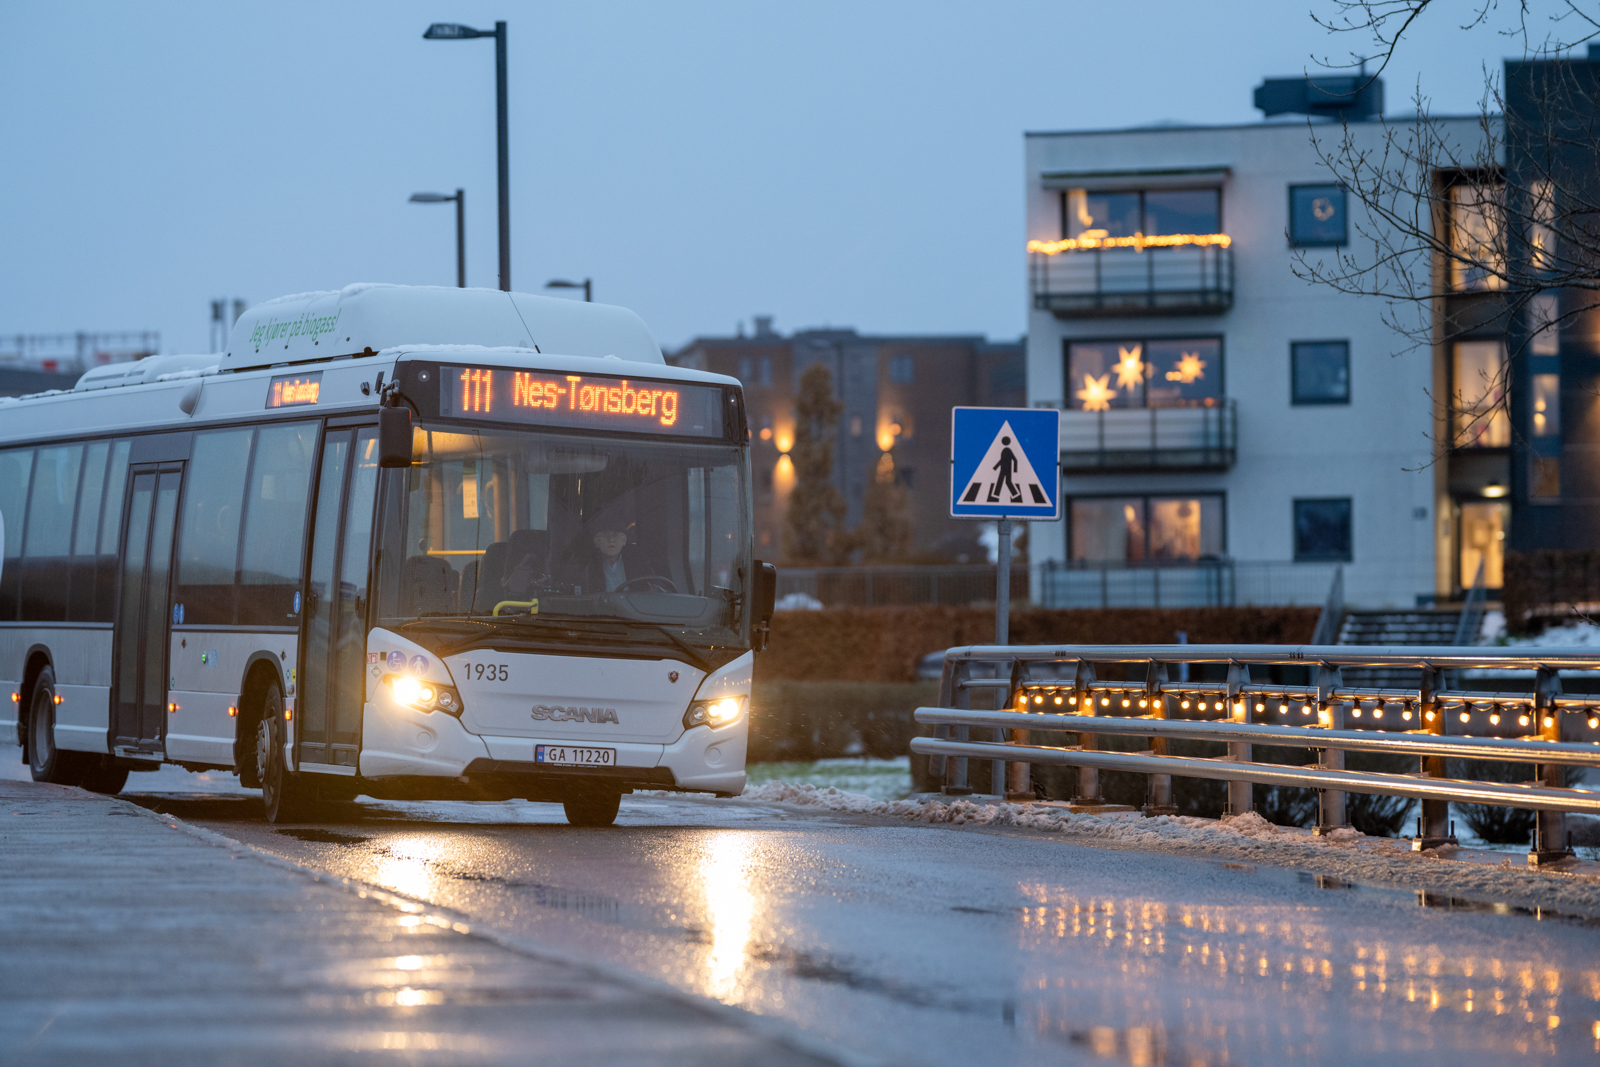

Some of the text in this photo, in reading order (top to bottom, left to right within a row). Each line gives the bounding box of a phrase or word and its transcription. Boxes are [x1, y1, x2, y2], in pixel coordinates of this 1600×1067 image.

[249, 308, 342, 349] Jeg kjører på biogass!
[460, 368, 678, 425] 111 Nes-Tønsberg
[464, 663, 509, 682] 1935
[531, 704, 620, 725] SCANIA
[548, 748, 566, 762] GA
[572, 749, 610, 764] 11220
